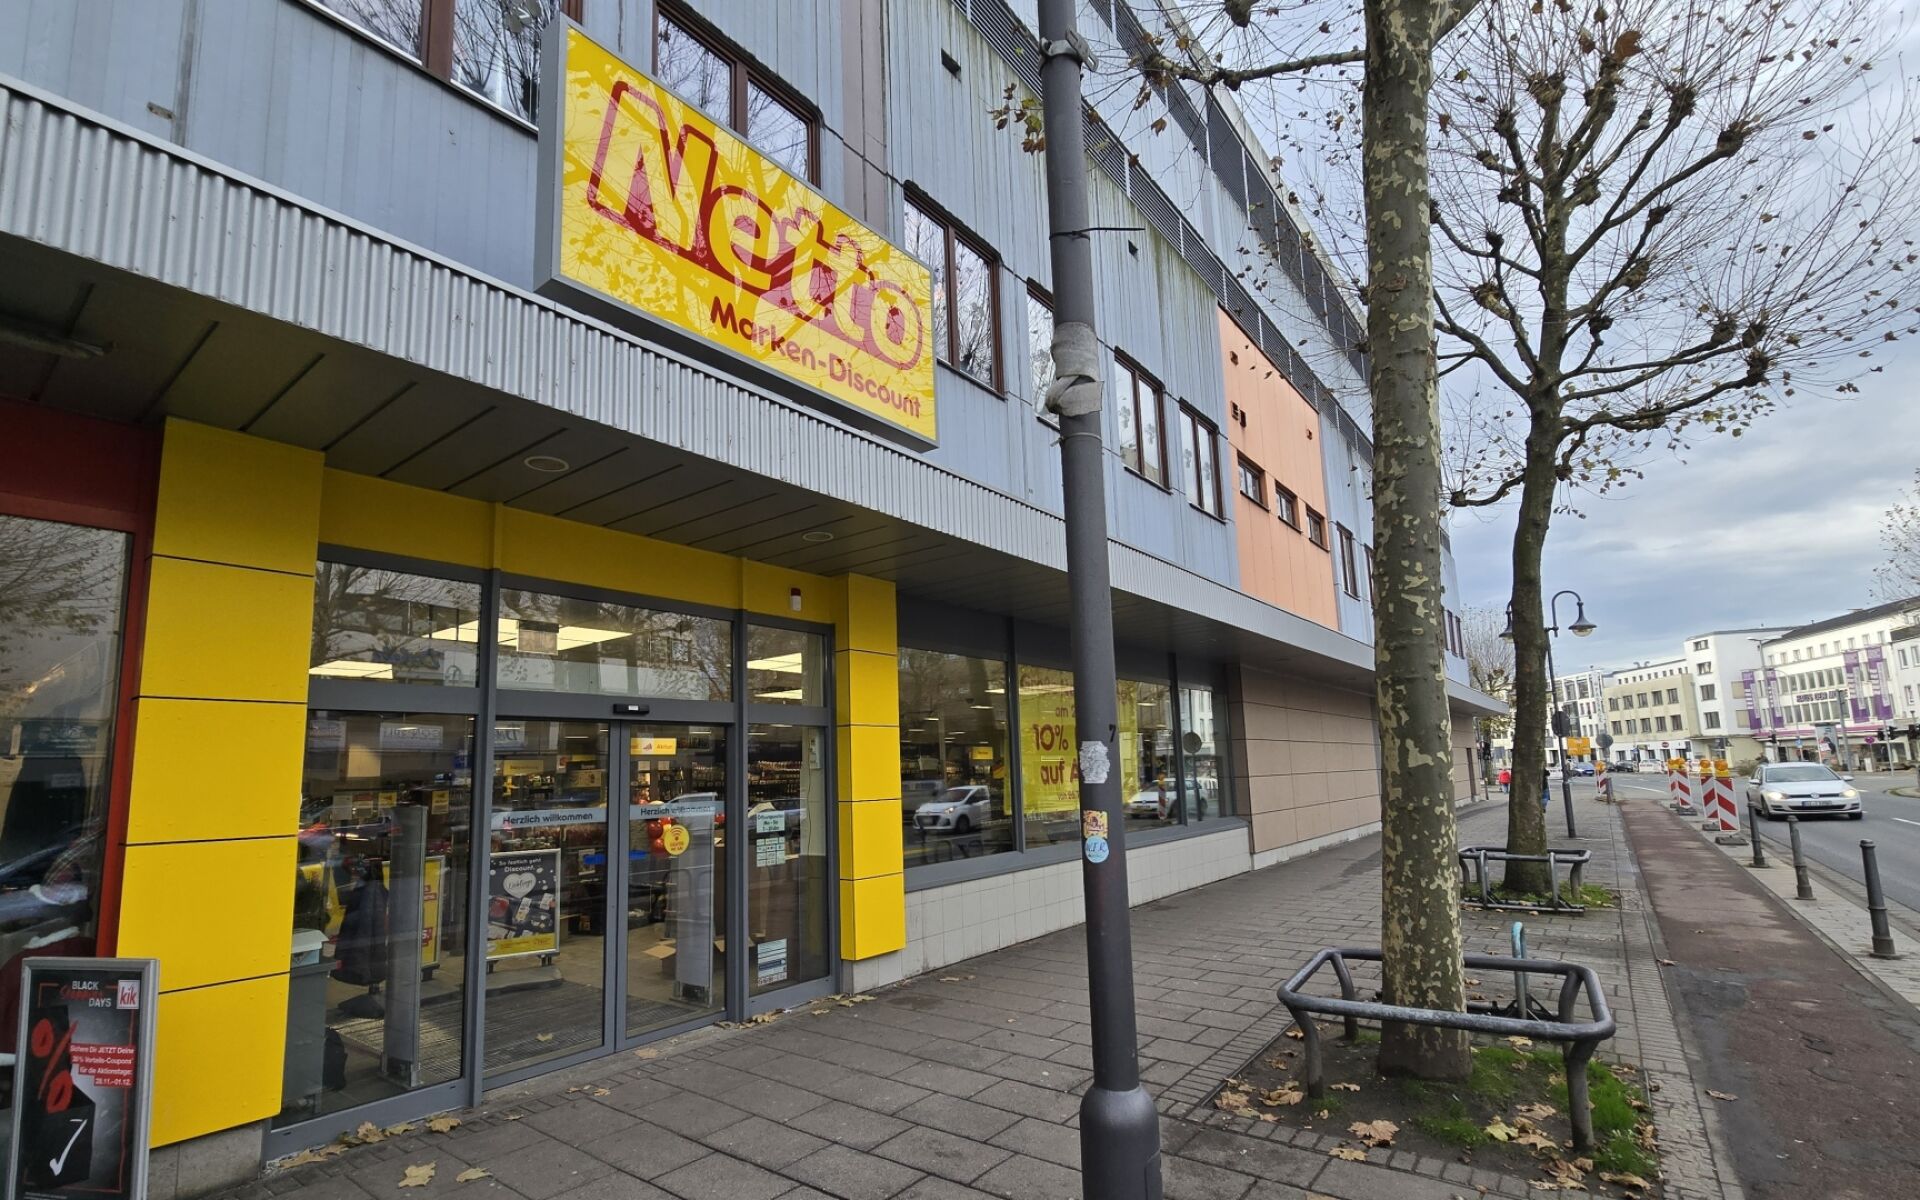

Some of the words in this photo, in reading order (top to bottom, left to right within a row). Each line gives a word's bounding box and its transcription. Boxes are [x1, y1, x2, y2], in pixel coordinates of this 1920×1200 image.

[587, 81, 922, 371] Netto
[710, 295, 922, 419] Marken-Discount
[1055, 705, 1069, 718] am
[1032, 723, 1069, 752] 10%
[1040, 758, 1065, 785] auf
[640, 806, 670, 816] Herzlich
[503, 814, 540, 825] Herzlich
[542, 811, 593, 823] willkommen
[504, 865, 535, 873] Discount.
[71, 980, 99, 991] BLACK
[88, 998, 112, 1008] DAYS
[98, 1046, 117, 1054] JETZT
[117, 1047, 135, 1055] Deine
